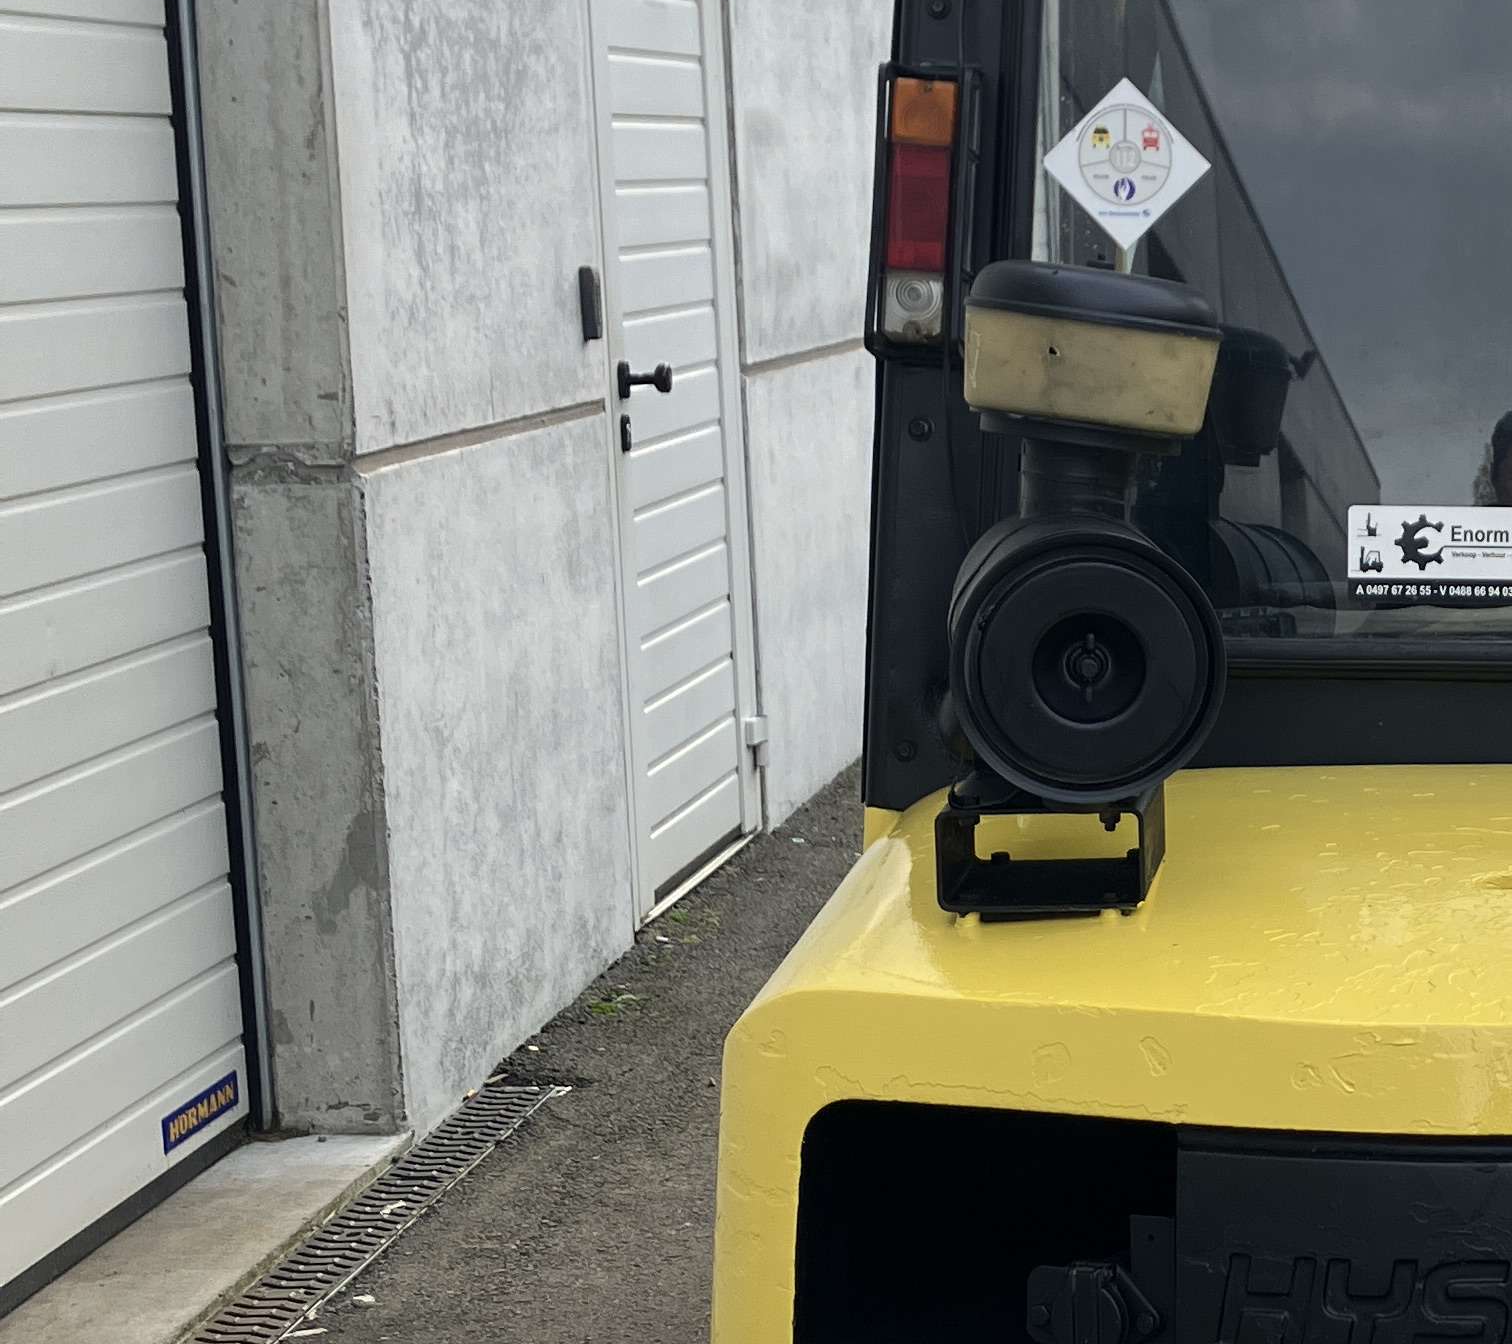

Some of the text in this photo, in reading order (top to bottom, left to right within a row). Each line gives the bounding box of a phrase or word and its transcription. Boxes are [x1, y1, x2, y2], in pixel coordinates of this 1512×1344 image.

[1451, 526, 1509, 543] Enorm
[1356, 584, 1364, 595] A
[1366, 585, 1388, 595] 0497
[1391, 585, 1403, 595] 67
[1419, 585, 1432, 596] 55
[1439, 585, 1447, 596] V
[1488, 586, 1500, 597] 94
